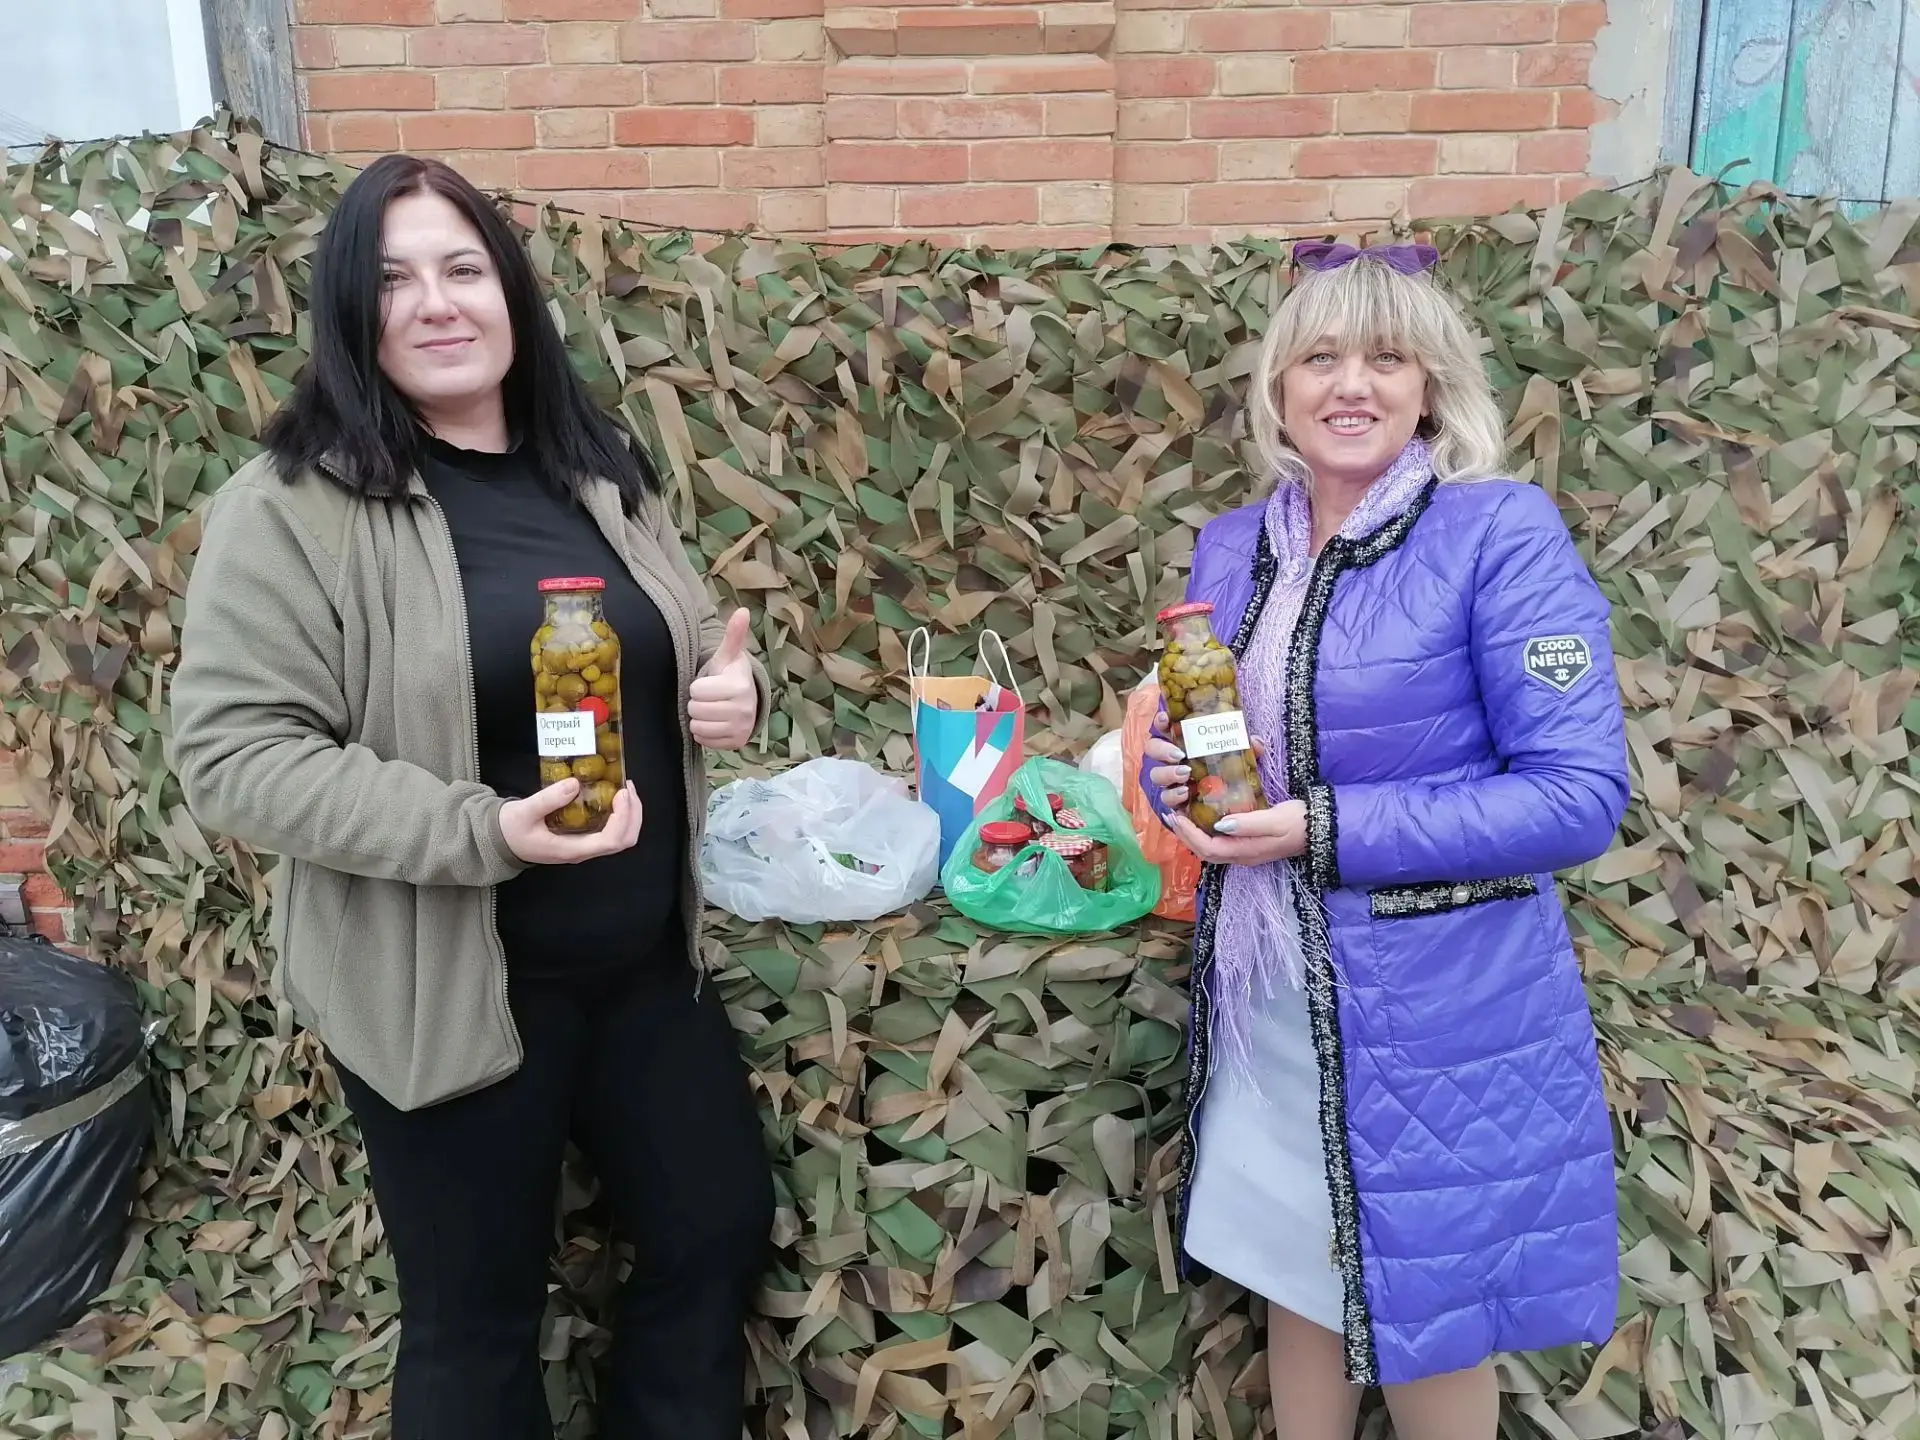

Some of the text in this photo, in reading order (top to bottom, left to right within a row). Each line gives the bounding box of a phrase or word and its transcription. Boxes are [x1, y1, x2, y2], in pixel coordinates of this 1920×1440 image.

[1537, 639, 1576, 652] COCO
[1529, 651, 1587, 669] NEIGE
[539, 716, 581, 731] Острый
[1197, 719, 1240, 736] Острый
[544, 736, 576, 748] перец
[1206, 737, 1240, 751] перец
